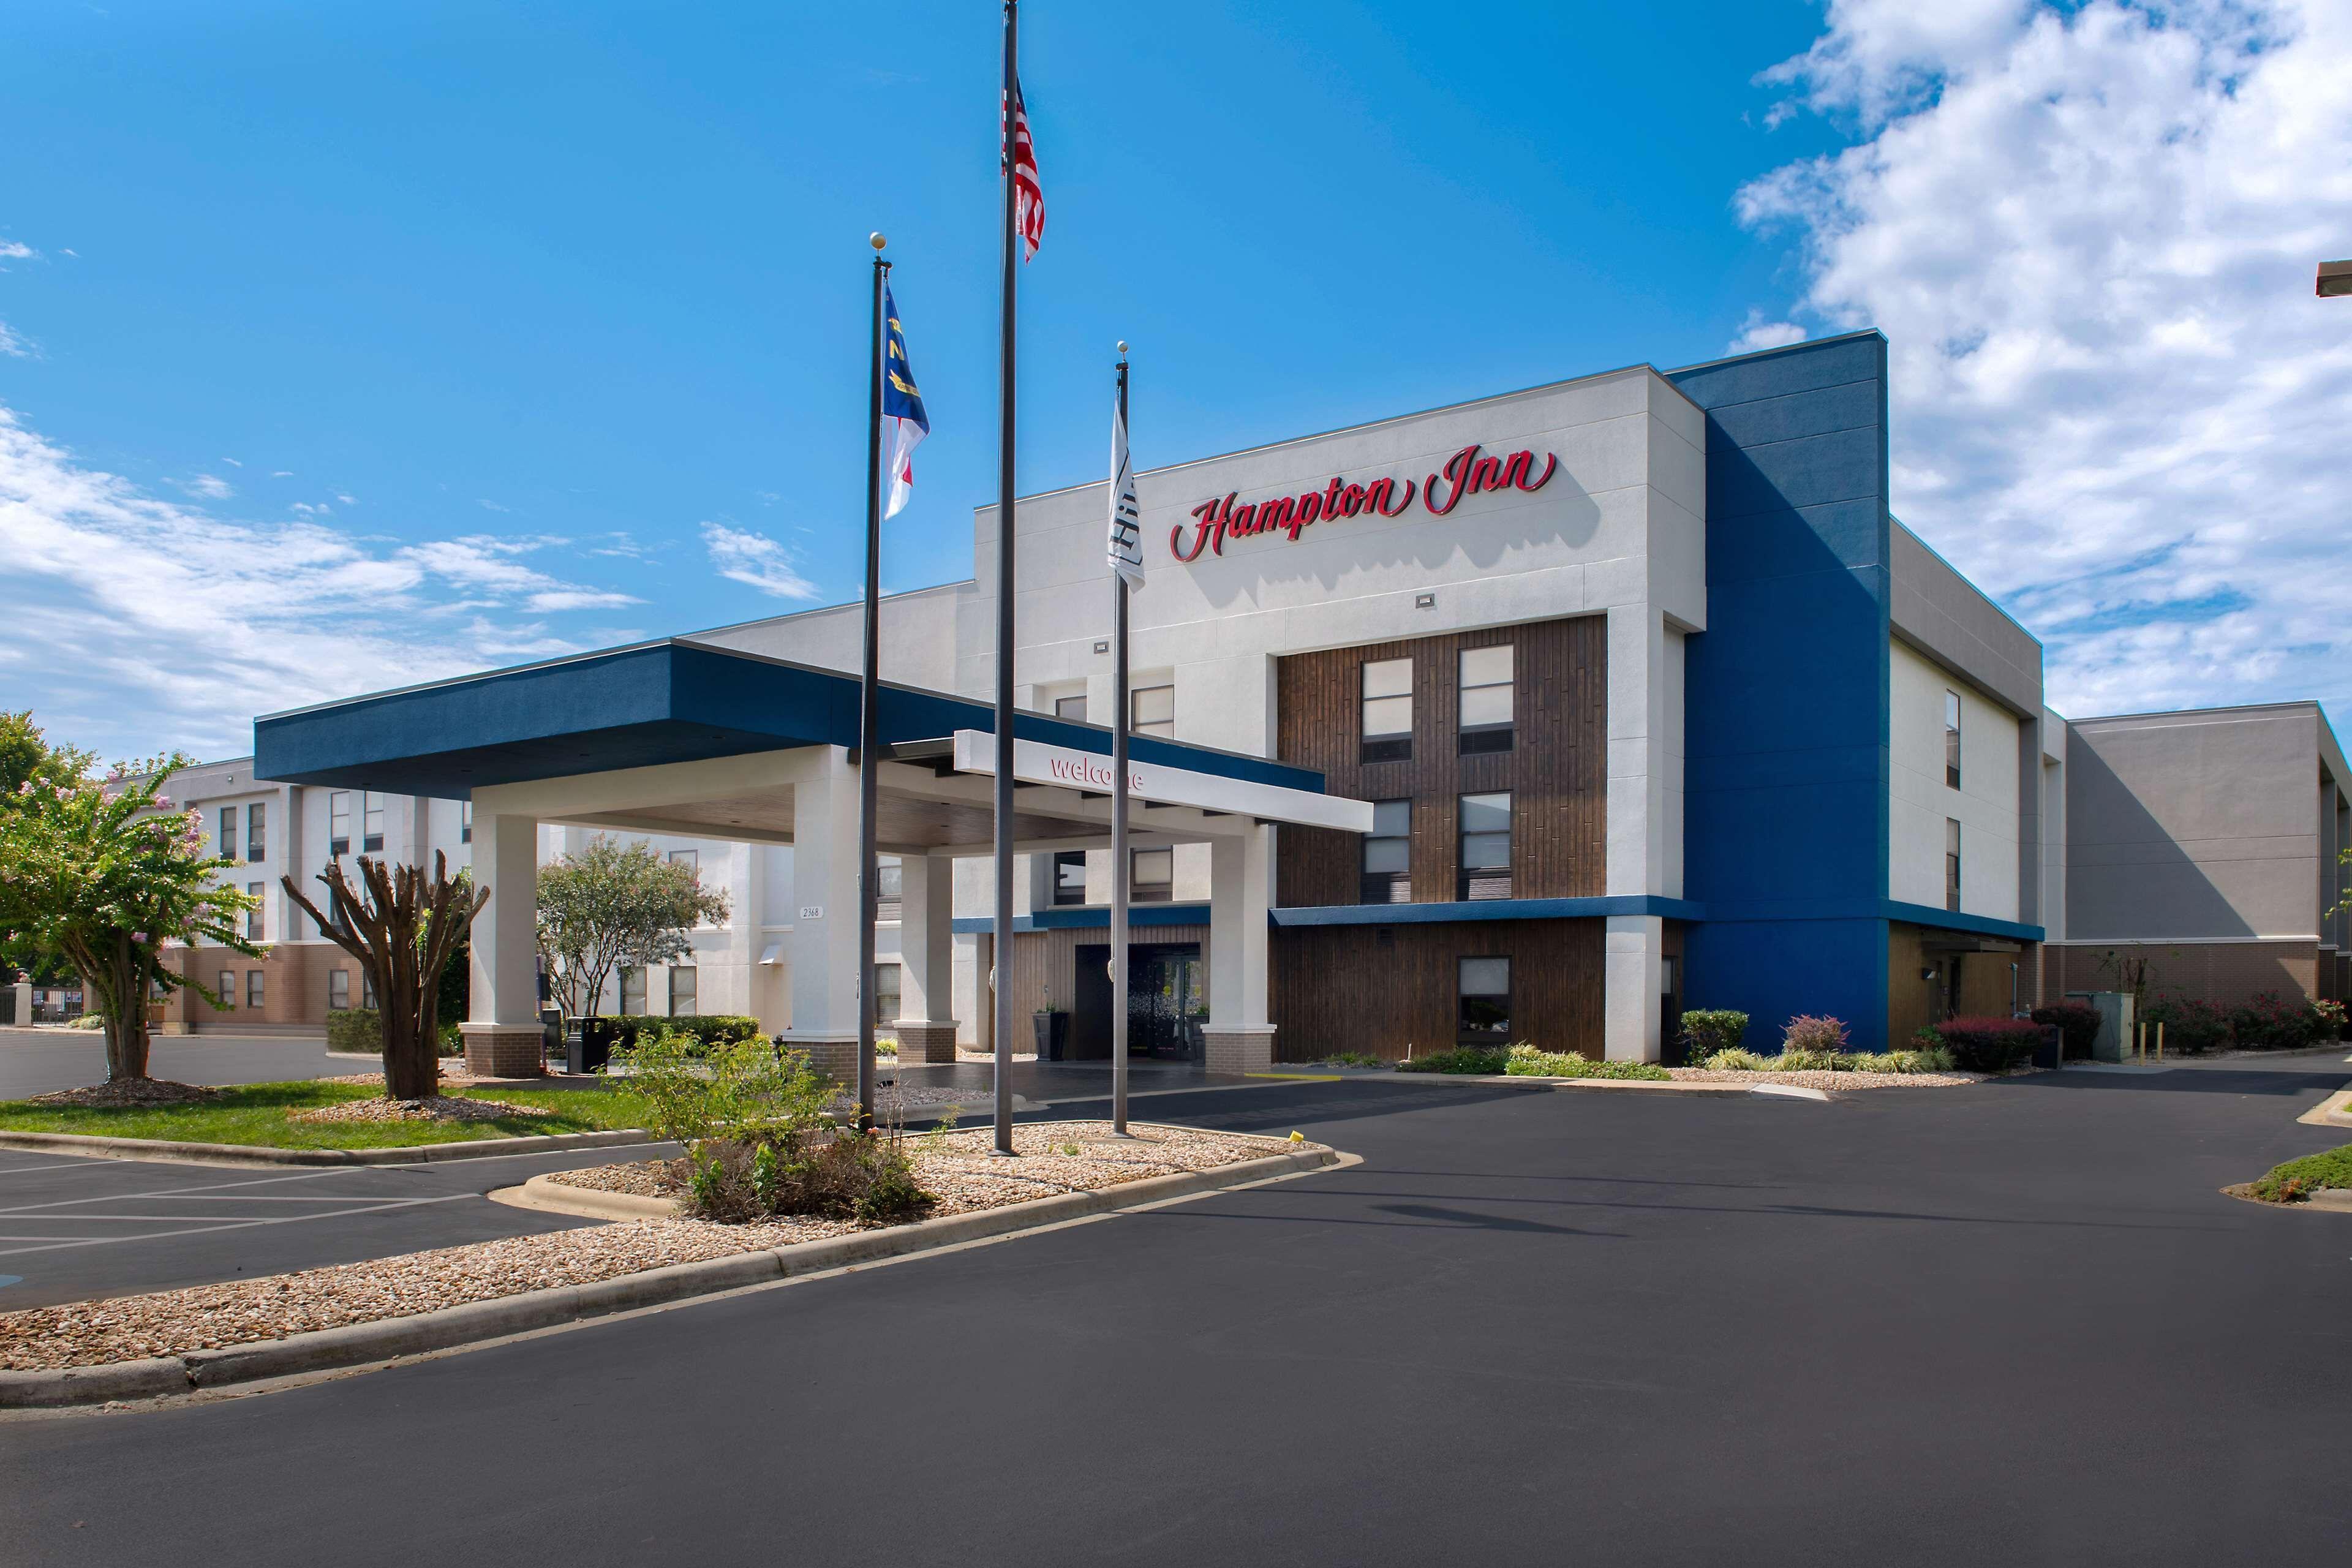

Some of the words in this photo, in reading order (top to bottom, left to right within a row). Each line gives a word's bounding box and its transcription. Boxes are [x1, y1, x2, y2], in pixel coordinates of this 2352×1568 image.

[1170, 477, 1415, 563] Hampton
[1423, 444, 1557, 516] Inn
[1051, 757, 1144, 791] welcoe
[804, 907, 819, 917] 2368
